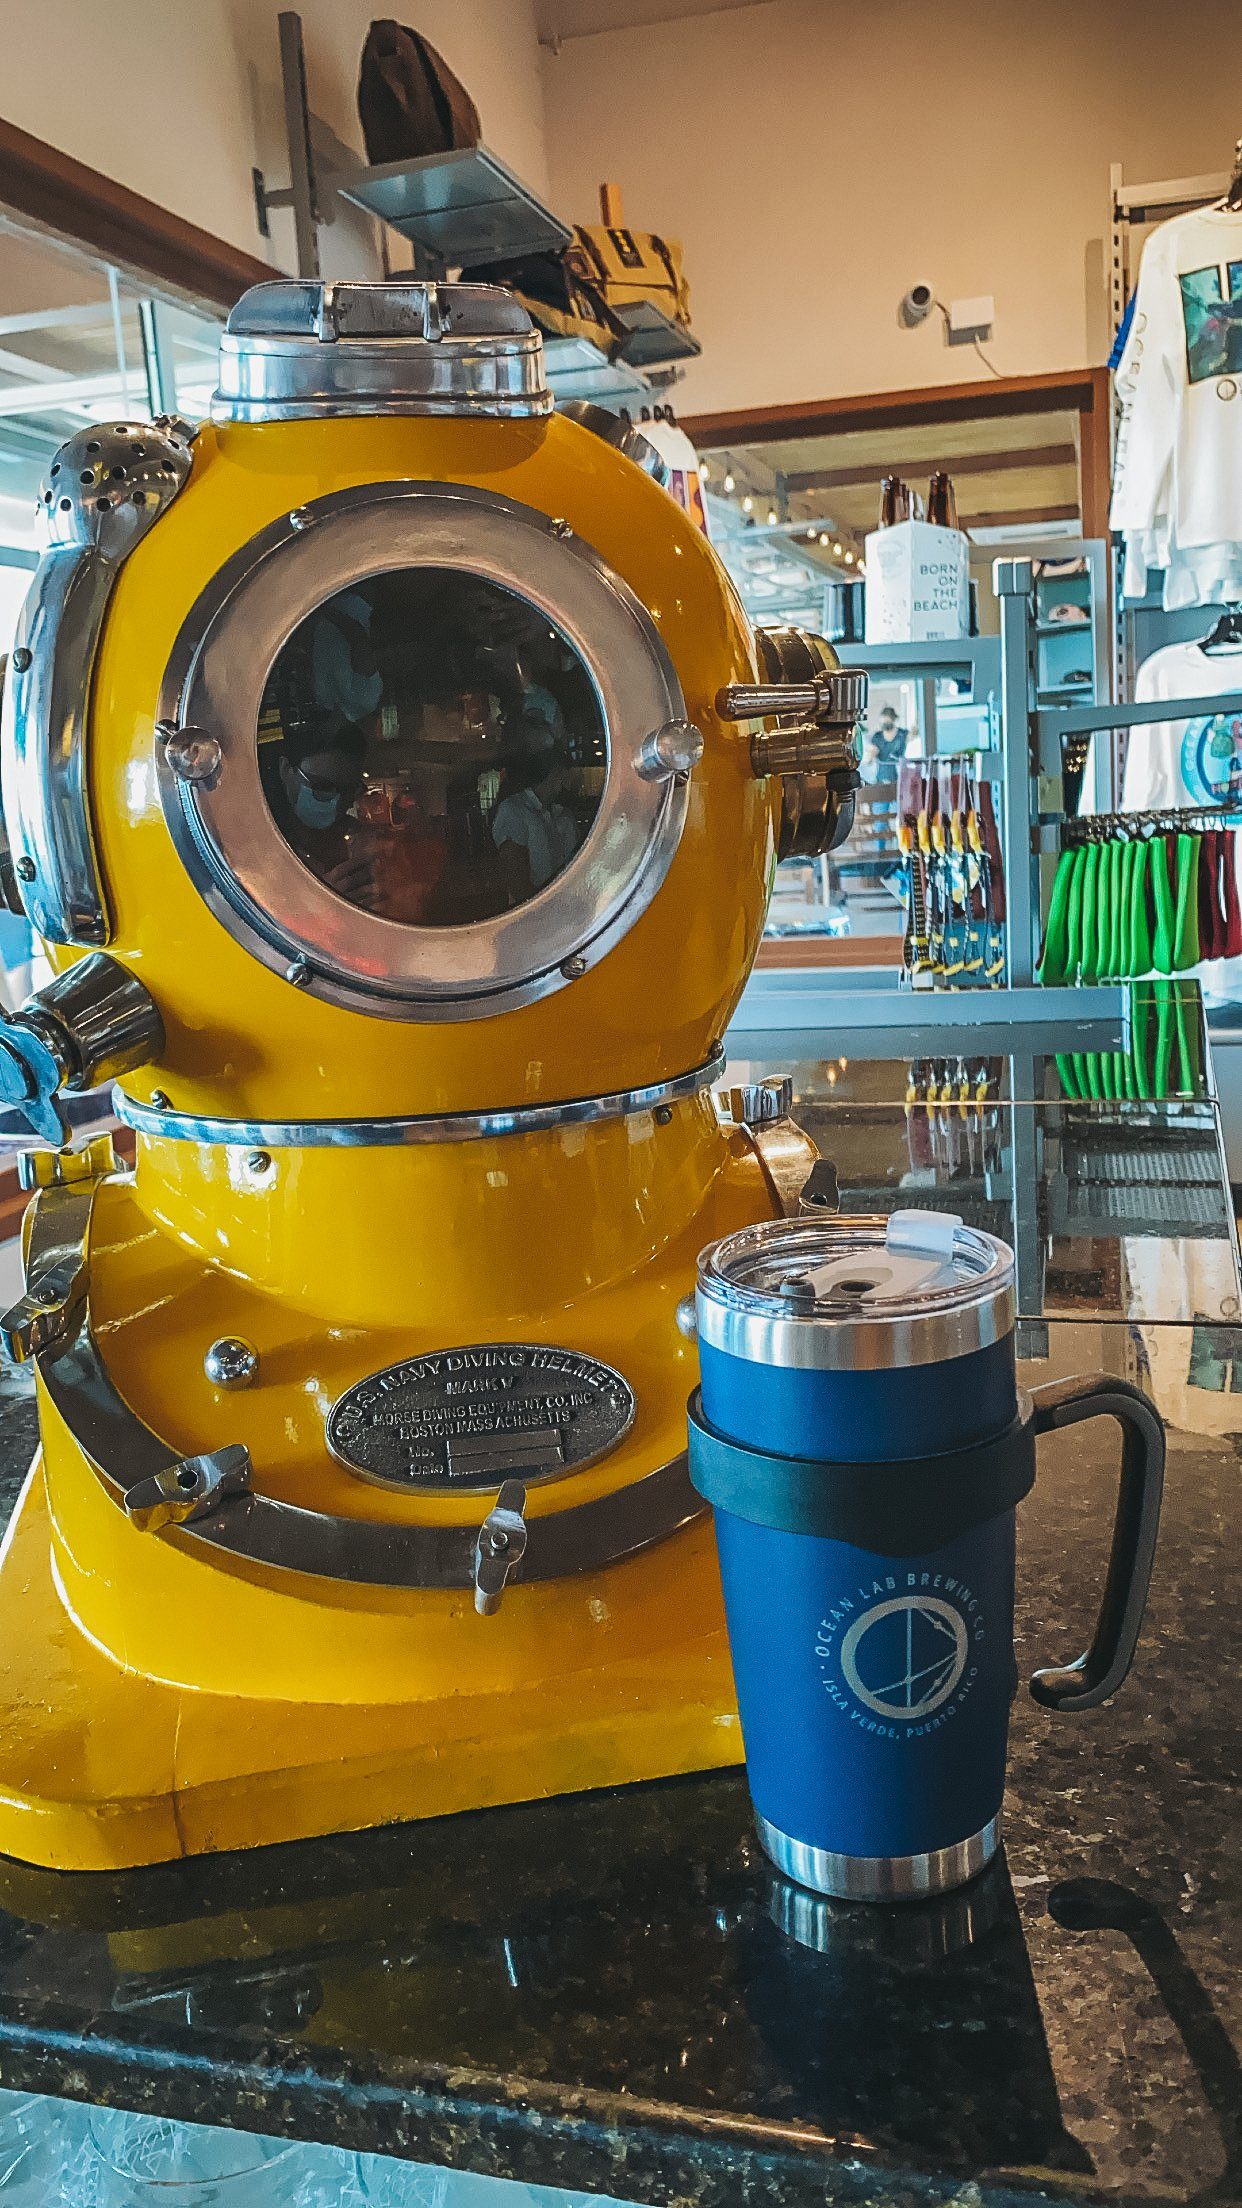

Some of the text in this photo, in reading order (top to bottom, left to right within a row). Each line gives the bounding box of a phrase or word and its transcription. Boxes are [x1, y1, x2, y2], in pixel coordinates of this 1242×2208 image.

[920, 563, 958, 576] BORN
[939, 576, 958, 587] ON
[933, 587, 958, 599] THE
[914, 600, 958, 612] BEACH
[379, 1360, 441, 1391] NAVY
[447, 1352, 525, 1372] DIVING
[531, 1353, 620, 1392] HELMET
[445, 1376, 515, 1396] MARK V
[422, 1405, 466, 1421] DIVING
[399, 1409, 571, 1440] BOSTON MASSACHUSETTS
[815, 1596, 854, 1658] OCEAN
[857, 1576, 896, 1599] LAB
[907, 1572, 978, 1612] BREWING
[822, 1680, 849, 1710] ISLA
[905, 1705, 957, 1738] PUERTO
